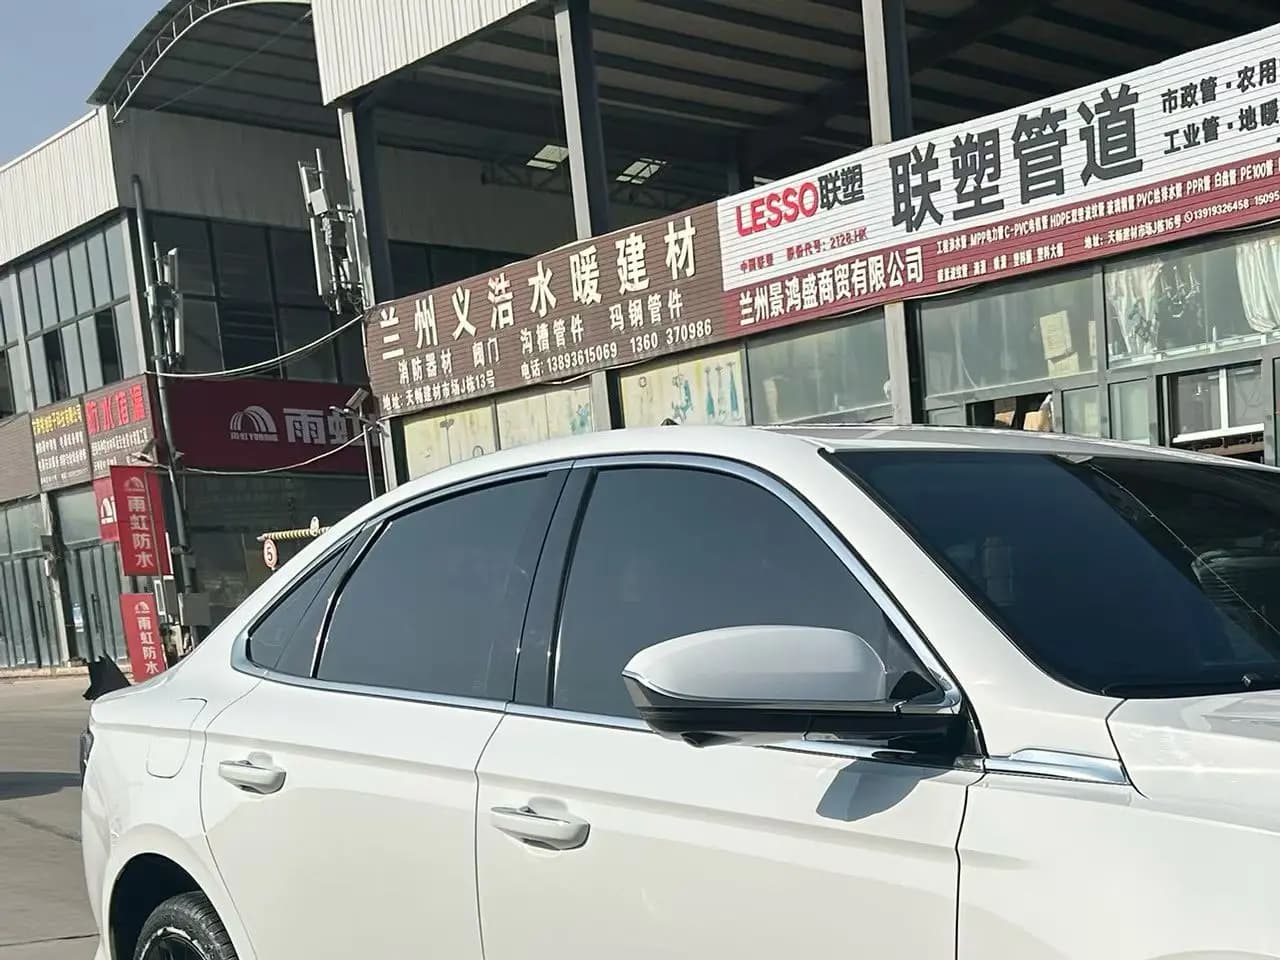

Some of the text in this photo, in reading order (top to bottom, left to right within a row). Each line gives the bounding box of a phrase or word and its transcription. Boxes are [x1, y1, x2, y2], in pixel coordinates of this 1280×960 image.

[888, 83, 1143, 234] 联塑管道
[735, 164, 865, 237] LESSO 联塑
[380, 216, 697, 360] 兰州义浩水暖建材
[738, 246, 924, 326] 兰州景鸿盛商贸有限公司
[398, 347, 452, 386] 消防器材
[472, 337, 500, 369] 阀门
[519, 313, 584, 355] 沟槽管件
[666, 318, 712, 345] 370986
[127, 496, 154, 568] 雨虹防水
[137, 616, 160, 675] 雨虹防水
